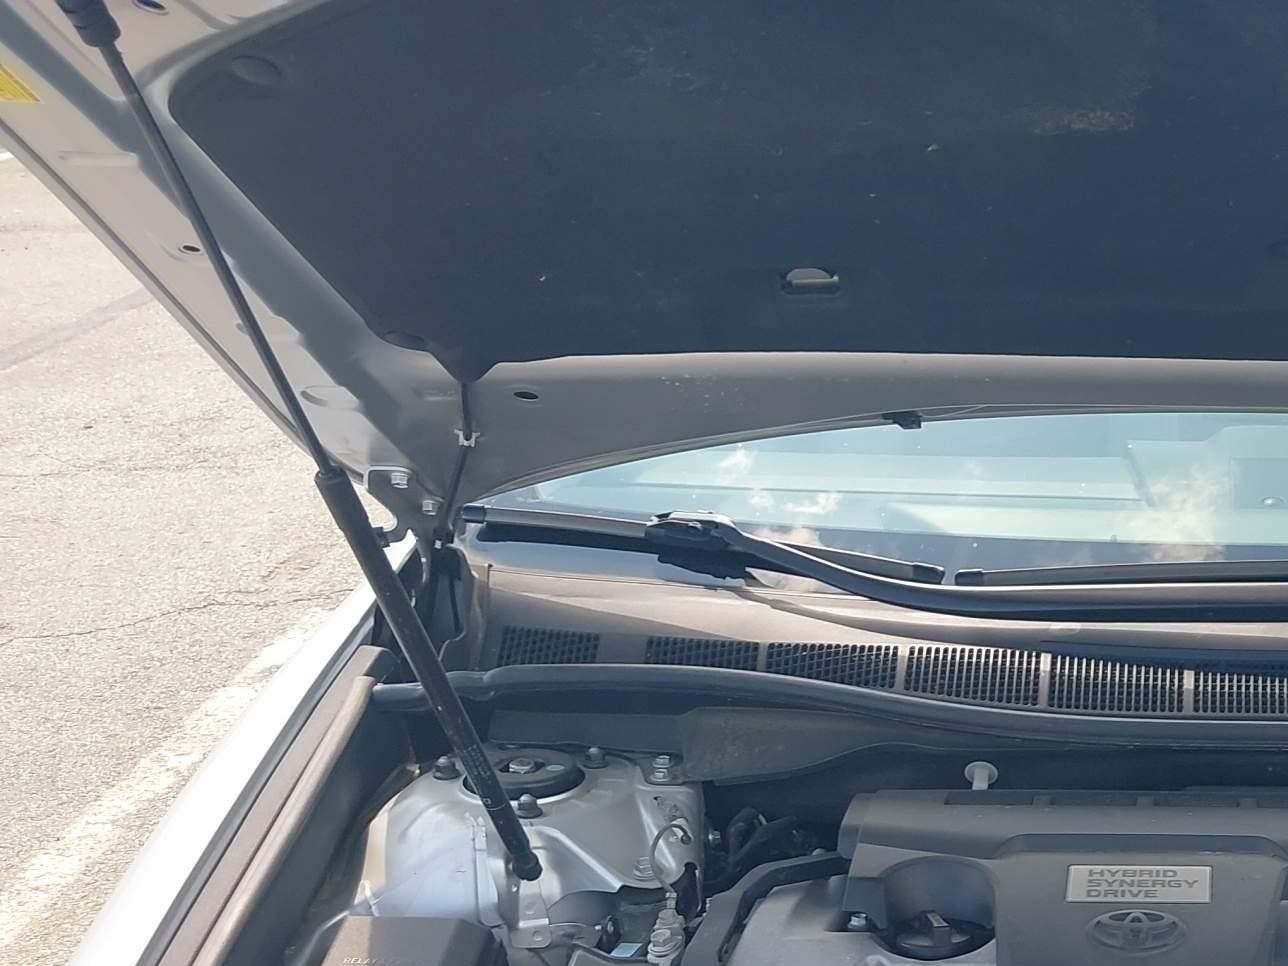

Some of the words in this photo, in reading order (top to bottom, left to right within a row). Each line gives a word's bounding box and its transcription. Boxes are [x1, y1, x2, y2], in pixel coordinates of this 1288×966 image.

[1088, 869, 1178, 877] HYBRID
[1087, 879, 1200, 888] SYNERGY
[1086, 889, 1159, 898] DRIVE
